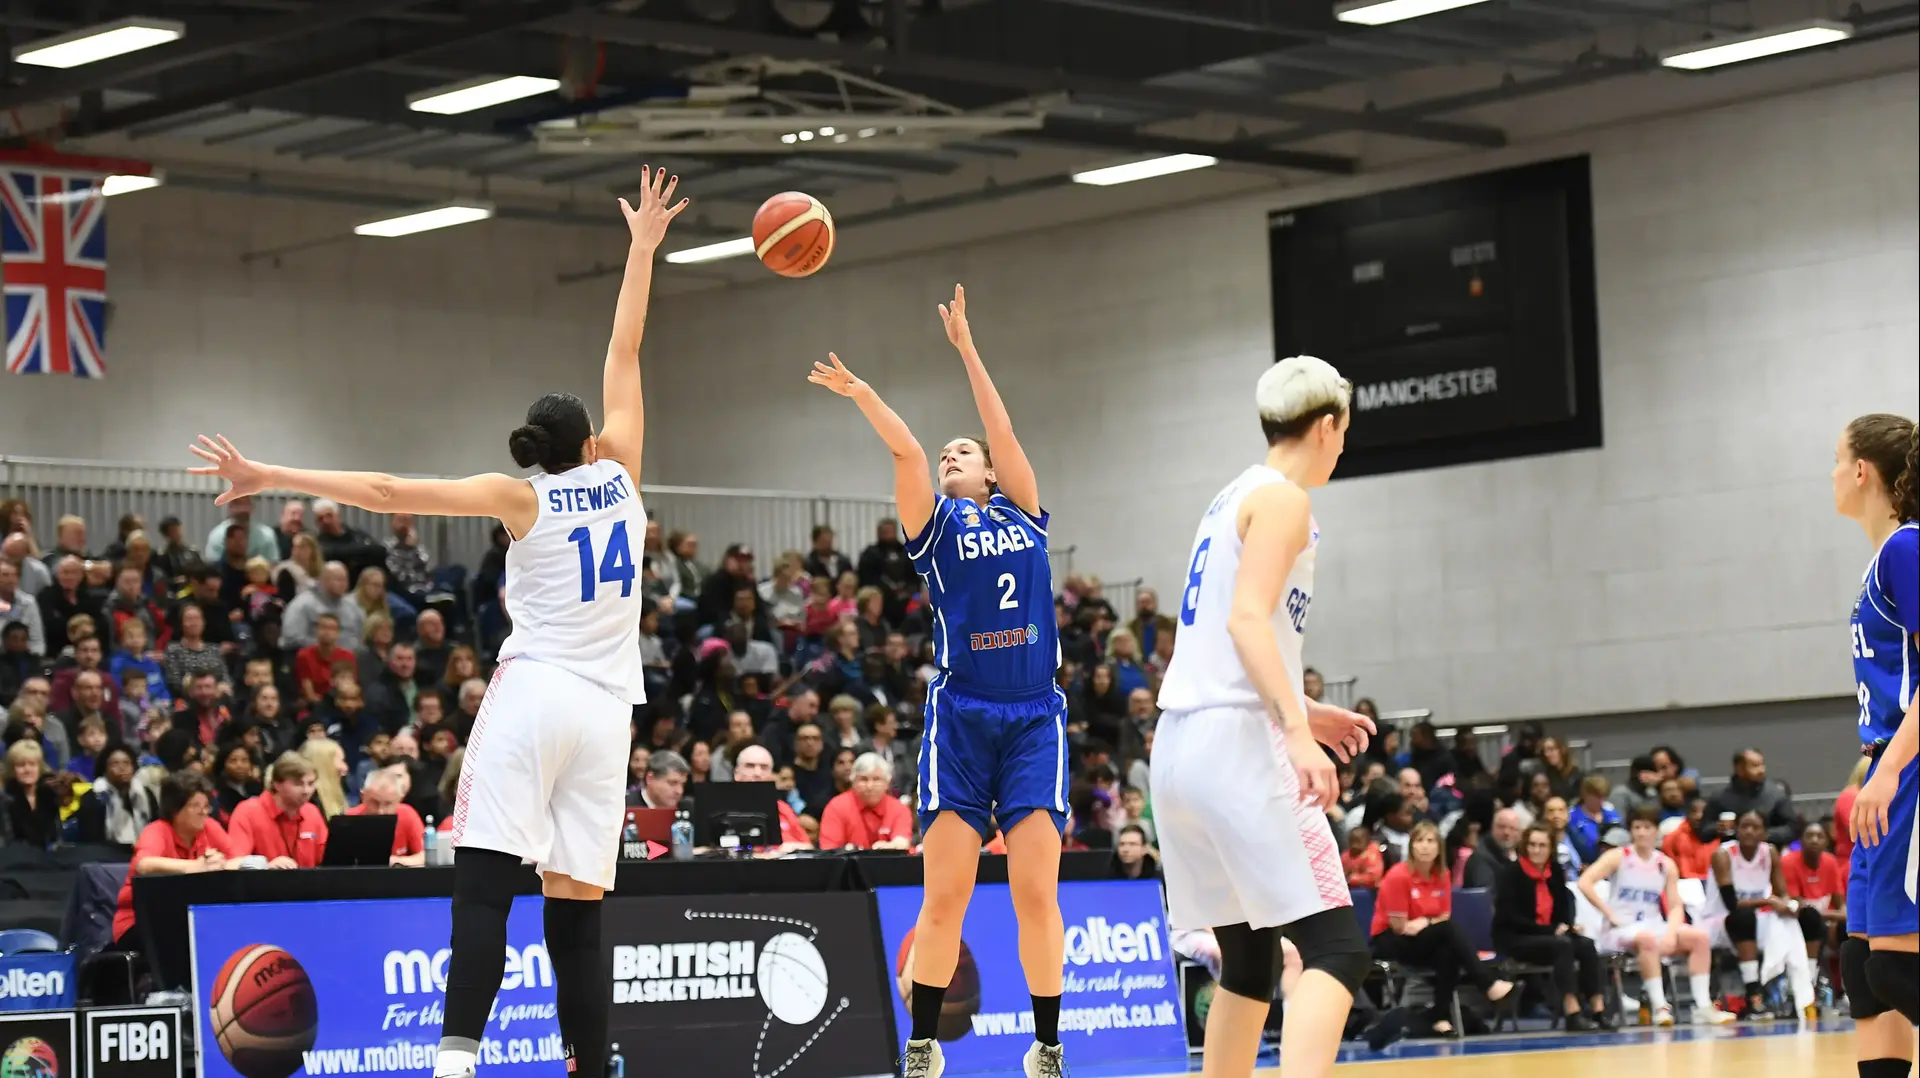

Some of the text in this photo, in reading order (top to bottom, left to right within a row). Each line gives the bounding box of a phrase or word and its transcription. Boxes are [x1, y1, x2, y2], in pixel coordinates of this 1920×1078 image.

[1356, 366, 1498, 412] MANCHESTER
[549, 474, 630, 513] STEWART
[568, 520, 635, 602] 14
[957, 525, 1035, 560] ISRAEL
[997, 572, 1019, 610] 2
[1180, 536, 1212, 627] 8
[970, 627, 1026, 651] תנובה
[623, 841, 648, 859] POSS
[612, 940, 756, 980] BRITISH
[1063, 916, 1162, 966] olten
[0, 967, 65, 999] olten
[612, 975, 756, 1004] BASKETBALL
[1088, 969, 1121, 992] real
[1122, 973, 1168, 999] game
[382, 1003, 418, 1031] For
[419, 1000, 444, 1026] th
[500, 1003, 557, 1031] game
[100, 1020, 170, 1063] FIBA
